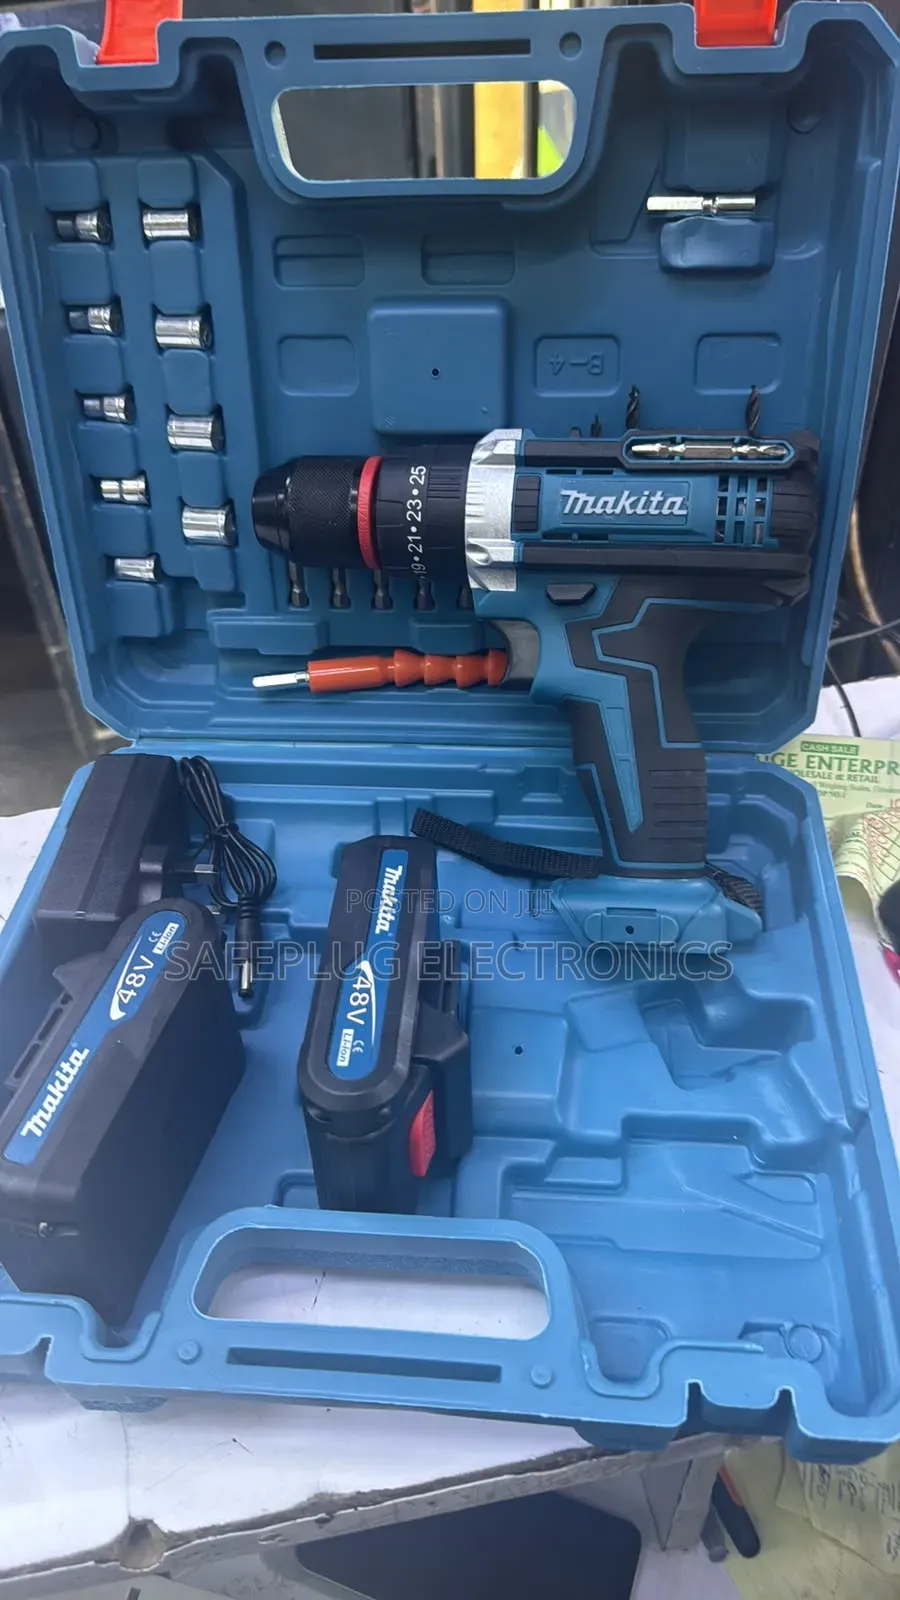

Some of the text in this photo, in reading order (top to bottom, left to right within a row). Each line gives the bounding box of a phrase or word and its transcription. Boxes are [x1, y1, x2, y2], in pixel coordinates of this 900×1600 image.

[409, 465, 427, 485] 25
[406, 499, 423, 522] 23
[407, 535, 423, 553] 21
[831, 745, 857, 755] SALE
[847, 774, 879, 784] RETAIL
[116, 954, 155, 1004] 48V
[346, 975, 373, 1025] 48V
